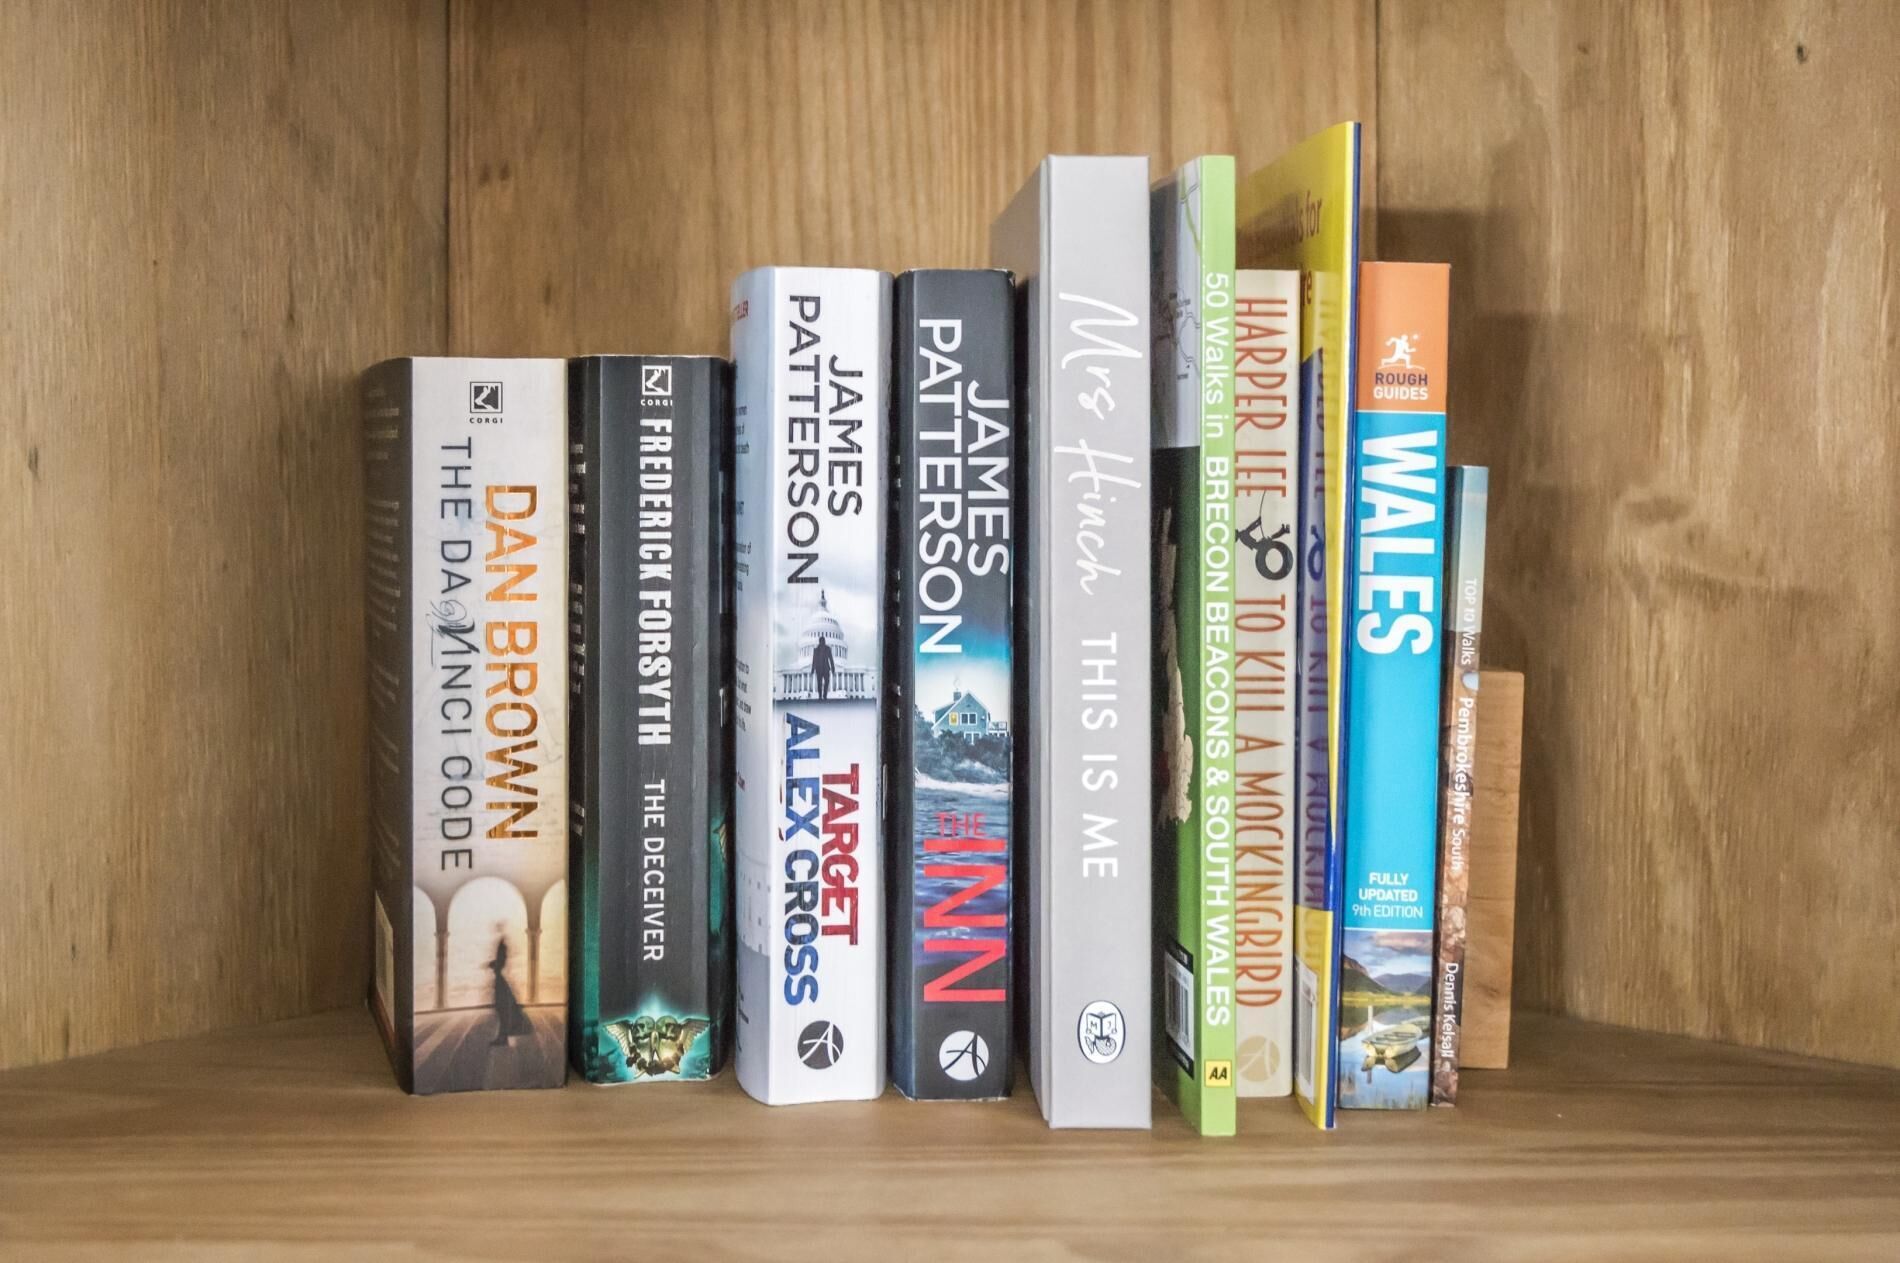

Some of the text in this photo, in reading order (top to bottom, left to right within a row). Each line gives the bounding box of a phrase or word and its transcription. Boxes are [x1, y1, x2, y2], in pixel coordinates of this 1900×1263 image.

[640, 399, 673, 407] CORGI
[787, 295, 821, 584] PATTERSON
[828, 354, 863, 516] JAMES
[1054, 292, 1143, 596] Mrs Hinch
[1235, 298, 1288, 498] HARPER LEE
[1373, 386, 1429, 400] GUIDES
[1375, 372, 1428, 385] ROUGH
[918, 318, 963, 653] PATTERSON
[967, 380, 1010, 577] JAMES
[1356, 430, 1438, 655] WALES
[437, 436, 479, 871] THE DA VINCI CODE
[485, 485, 538, 840] DAN BROWN
[638, 418, 672, 745] FREDERICK FORSYTH
[1205, 273, 1230, 1027] 50 Walks in BRECON BEACONS & SOUTH WALES
[1461, 625, 1476, 666] Walks
[1463, 578, 1478, 604] TOP
[935, 812, 985, 837] THE
[1081, 632, 1119, 878] THIS IS ME
[1235, 594, 1286, 1008] TO KILL A MOCKINGBIRD
[1452, 697, 1474, 825] Pembrokeshire
[643, 779, 666, 961] THE DECEIVER
[784, 712, 820, 1007] ALEX CROSS
[821, 763, 860, 946] TARGET
[924, 839, 1006, 1002] INN
[1352, 903, 1424, 919] 9th EDITION
[1358, 887, 1419, 902] UPDATED
[1368, 871, 1410, 886] FULLY
[1450, 828, 1466, 871] South
[1208, 1066, 1229, 1081] AA
[1440, 962, 1460, 1058] Dennis Kelsall
